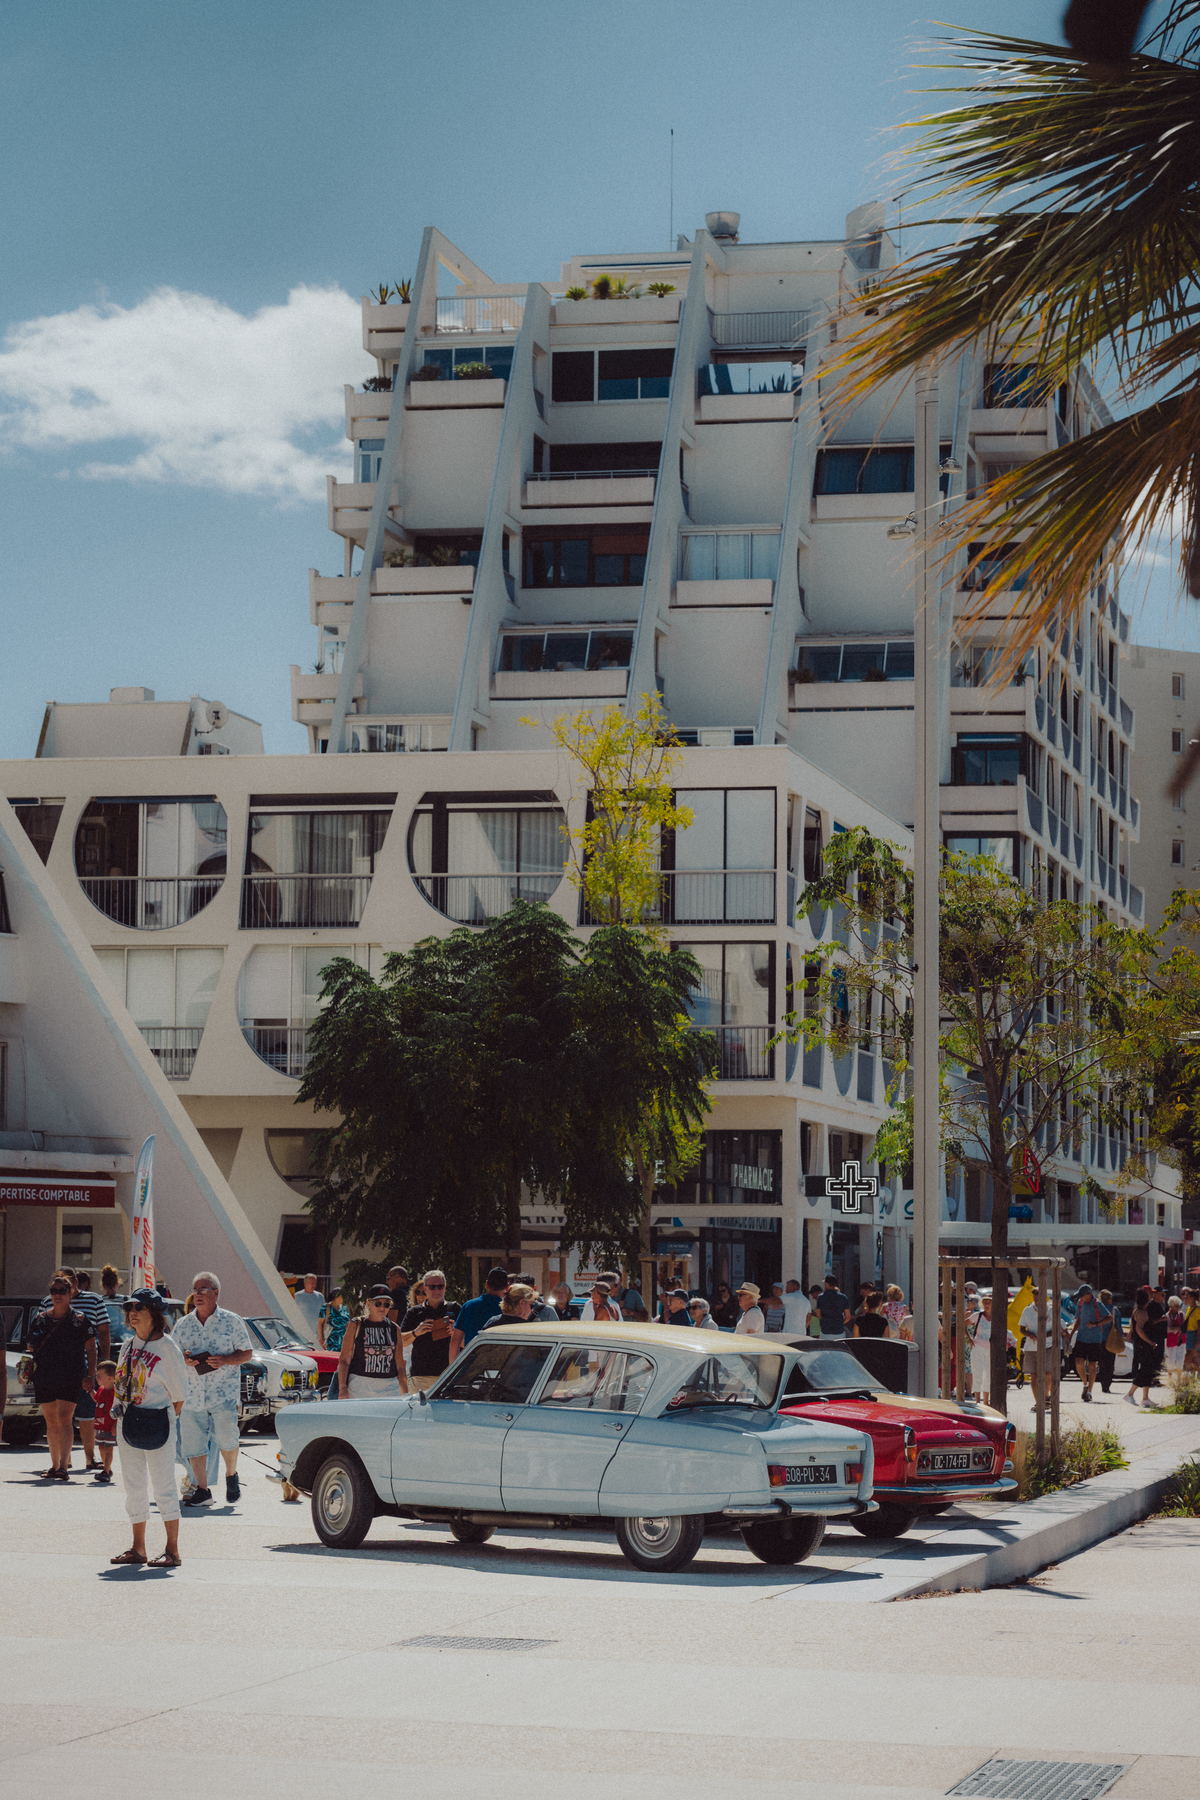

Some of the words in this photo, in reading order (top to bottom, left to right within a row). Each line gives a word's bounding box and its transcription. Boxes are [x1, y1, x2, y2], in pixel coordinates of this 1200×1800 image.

[731, 1163, 773, 1192] PHARMACIE
[364, 1327, 386, 1345] GUNS
[364, 1354, 392, 1373] ROSES
